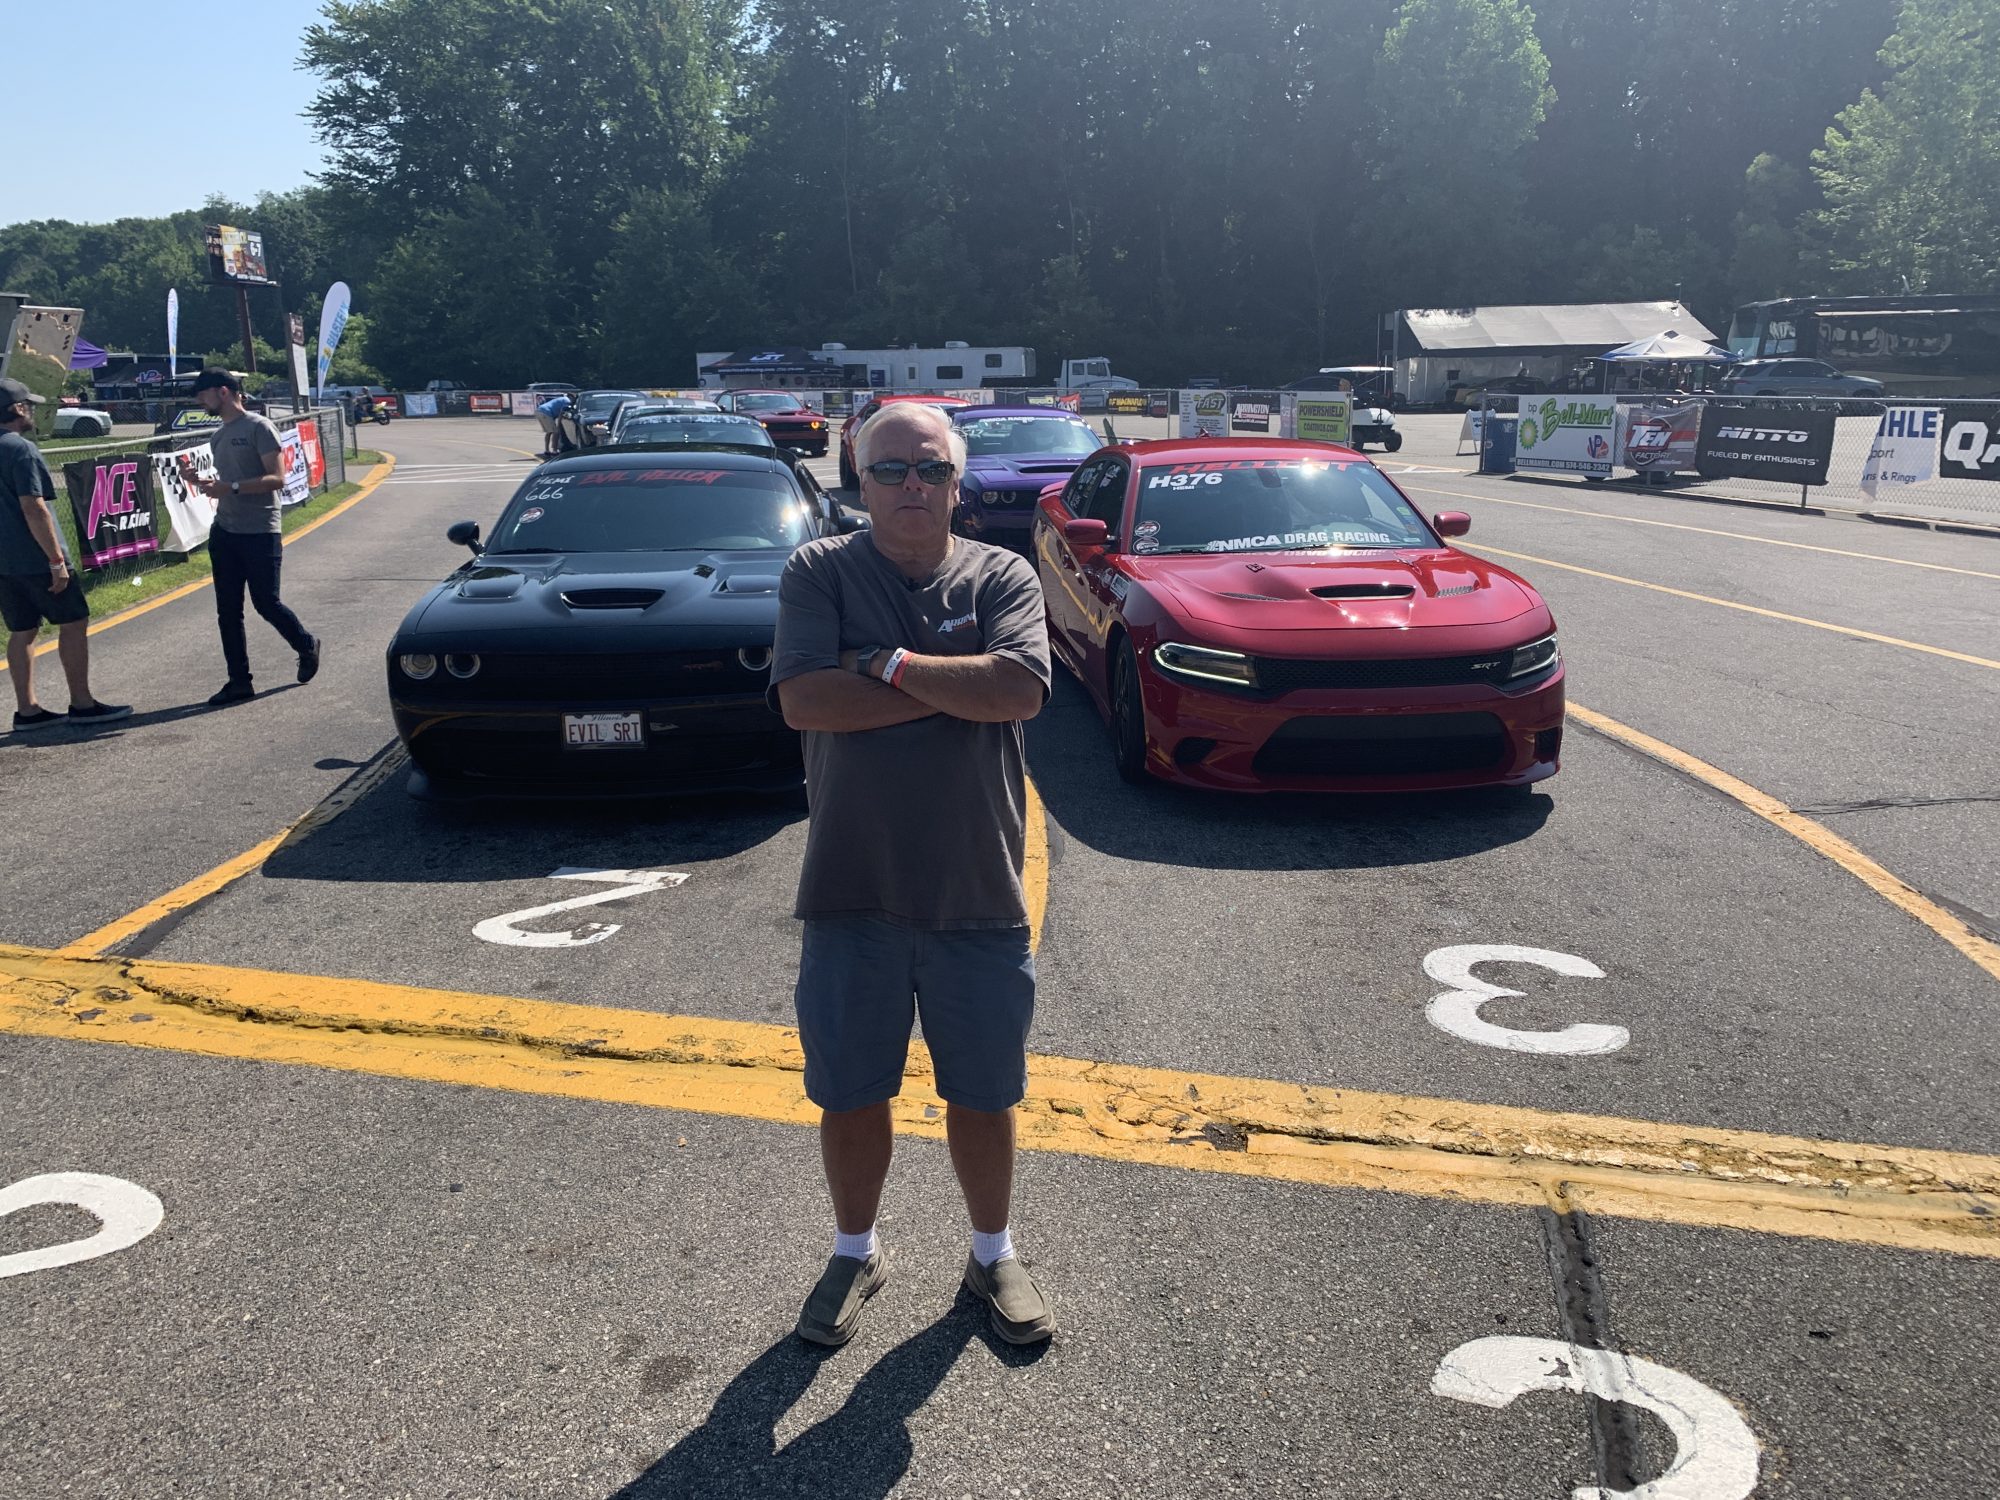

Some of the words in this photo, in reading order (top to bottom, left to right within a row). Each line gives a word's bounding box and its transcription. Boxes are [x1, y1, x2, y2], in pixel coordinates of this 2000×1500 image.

[1197, 398, 1224, 409] FAST
[1299, 405, 1344, 417] POWERSHIELD
[1528, 402, 1538, 413] bp
[1539, 398, 1614, 441] Bell-Mart
[1628, 425, 1672, 448] TEN
[1717, 426, 1809, 443] NITTO
[1635, 451, 1672, 459] FACTORY
[1707, 450, 1739, 459] FUELED
[1754, 454, 1816, 466] ENTHUSIASTS
[579, 470, 631, 486] EVIL
[1148, 473, 1223, 489] H376
[1891, 471, 1918, 485] Rings
[88, 462, 138, 539] ACE
[525, 487, 564, 501] 666
[119, 509, 151, 531] RACING
[1217, 534, 1282, 552] NMCA
[1284, 533, 1328, 544] DRAG
[1333, 531, 1391, 543] RACING
[1471, 661, 1501, 670] SRT
[569, 723, 604, 743] EVIL
[614, 721, 640, 742] SRT
